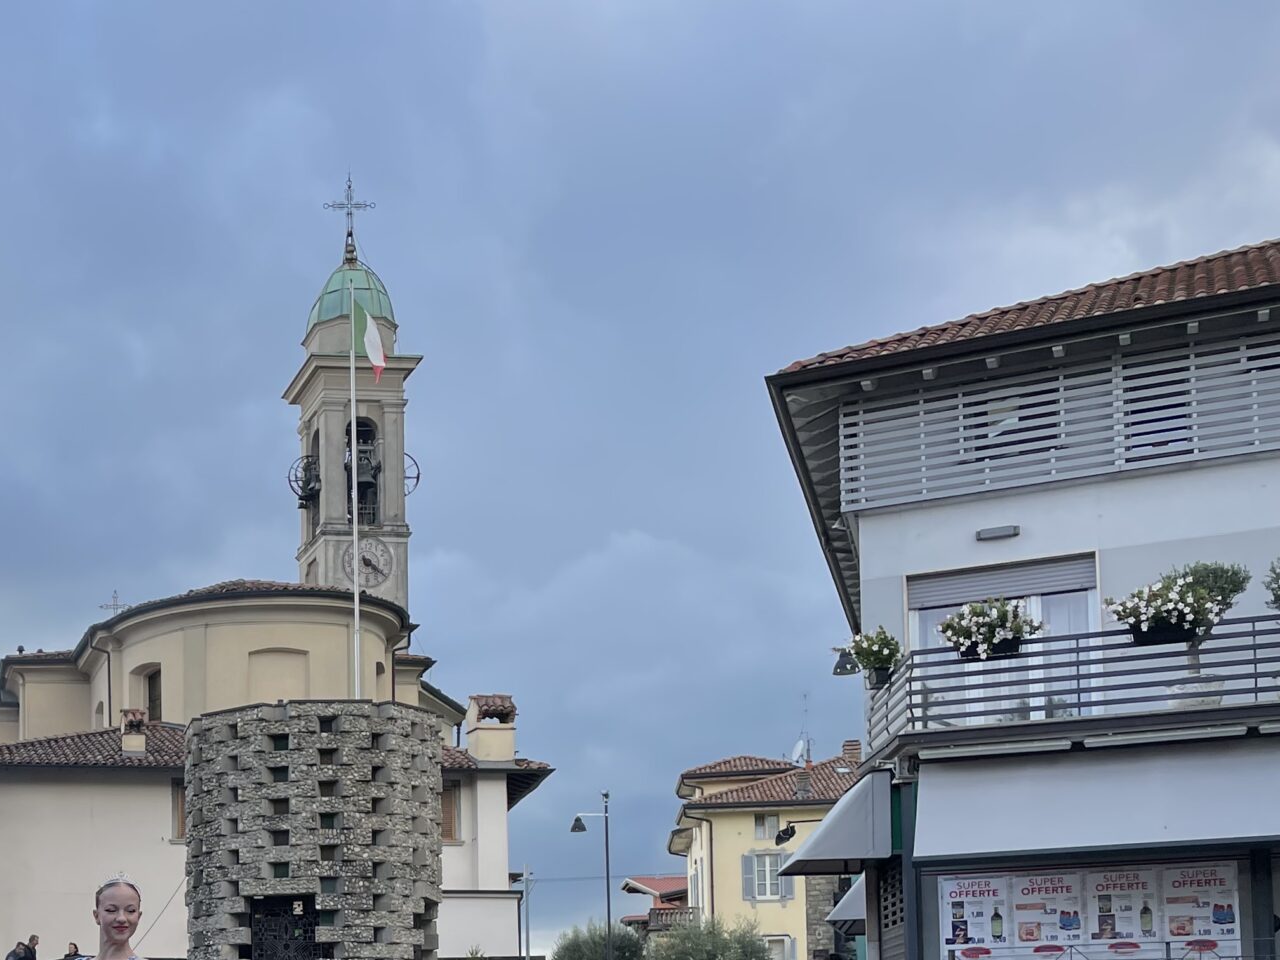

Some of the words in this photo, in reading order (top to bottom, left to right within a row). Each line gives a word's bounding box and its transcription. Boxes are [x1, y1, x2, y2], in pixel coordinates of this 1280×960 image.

[1103, 873, 1140, 882] SUPER
[1180, 870, 1217, 879] SUPER
[956, 881, 991, 890] SUPER
[1028, 878, 1064, 887] SUPER
[1096, 881, 1148, 892] OFFERTE
[1172, 878, 1227, 888] OFFERTE
[949, 889, 999, 898] OFFERTE
[1021, 885, 1072, 896] OFFERTE
